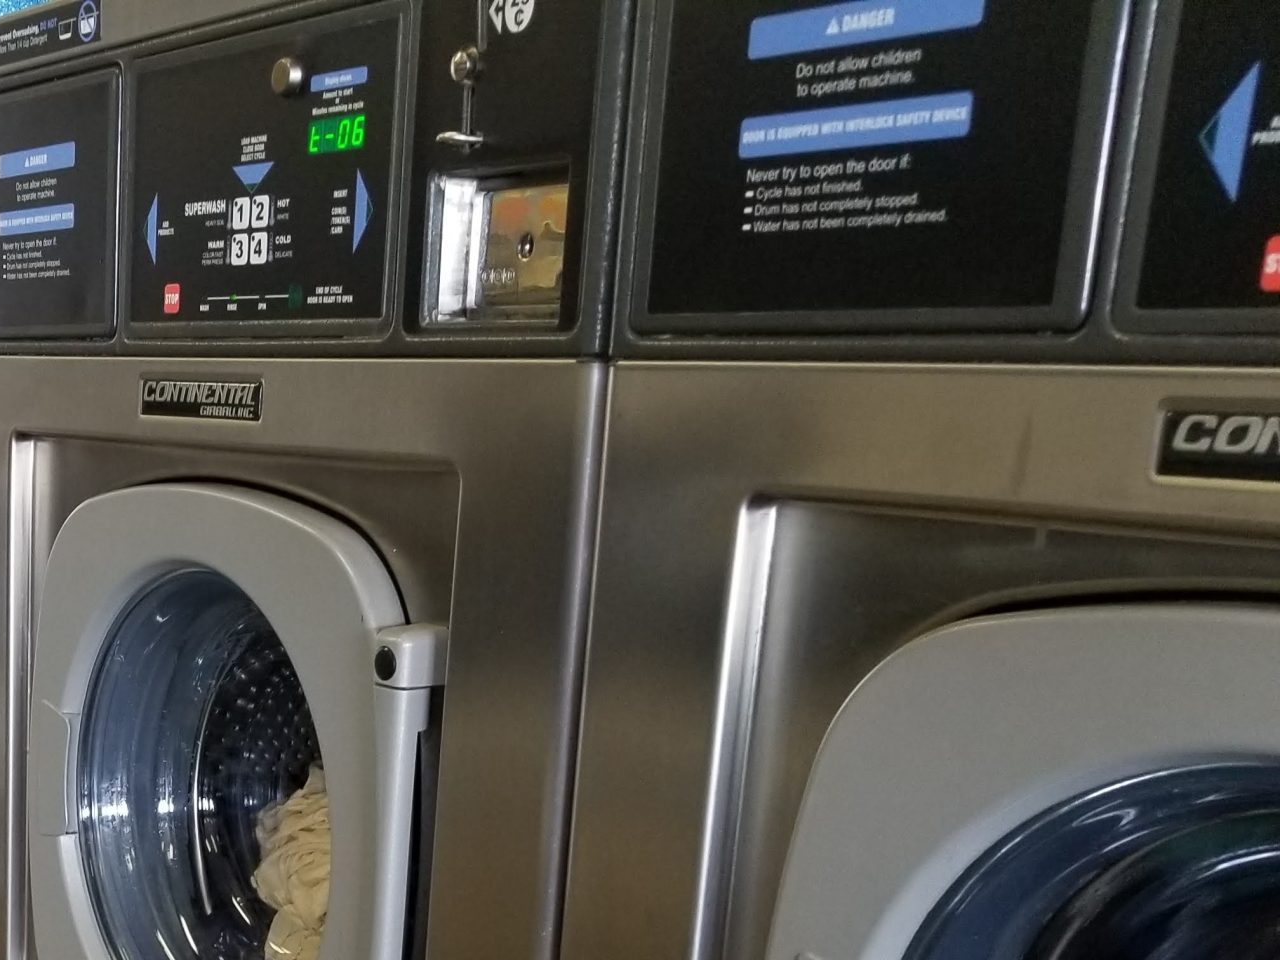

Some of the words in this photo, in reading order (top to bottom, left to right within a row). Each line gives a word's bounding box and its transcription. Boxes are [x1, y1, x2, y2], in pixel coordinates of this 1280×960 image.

[47, 18, 57, 29] NOT
[841, 8, 895, 33] DANGER
[795, 62, 813, 79] Do
[815, 59, 836, 75] not
[837, 55, 869, 72] allow
[871, 48, 922, 67] children
[796, 82, 808, 97] to
[810, 76, 856, 97] operate
[858, 69, 916, 88] machine.
[767, 127, 776, 141] IS
[777, 124, 819, 139] EQUIPPED
[821, 120, 844, 135] WITH
[845, 114, 895, 132] INTERLOCK
[896, 109, 930, 128] SAFETY
[932, 106, 968, 124] DEVICE
[29, 153, 48, 166] DANGER
[746, 168, 779, 183] Never
[782, 166, 797, 182] try
[799, 164, 812, 179] to
[813, 162, 844, 179] open
[846, 158, 865, 173] the
[868, 155, 897, 172] door
[899, 152, 912, 169] if:
[15, 181, 23, 191] Do
[30, 179, 40, 189] allow
[41, 177, 57, 187] children
[756, 186, 782, 202] Cycle
[784, 184, 802, 197] has
[804, 181, 820, 195] not
[821, 179, 863, 193] finished.
[184, 199, 227, 217] SUPERWASH
[236, 203, 243, 223] 1
[256, 202, 264, 221] 2
[277, 198, 290, 208] HOT
[754, 204, 780, 216] Drum
[782, 201, 800, 214] has
[802, 200, 818, 212] not
[819, 196, 874, 212] completely
[753, 220, 781, 233] Water
[782, 218, 800, 231] has
[801, 218, 819, 230] not
[820, 217, 845, 229] been
[846, 212, 902, 228] completely
[208, 240, 225, 249] WARM
[236, 239, 243, 258] 3
[253, 238, 262, 258] 4
[275, 234, 291, 244] COLD
[165, 293, 179, 305] STOP
[143, 381, 255, 405] CONTINENTAL
[1172, 414, 1280, 454] CON
